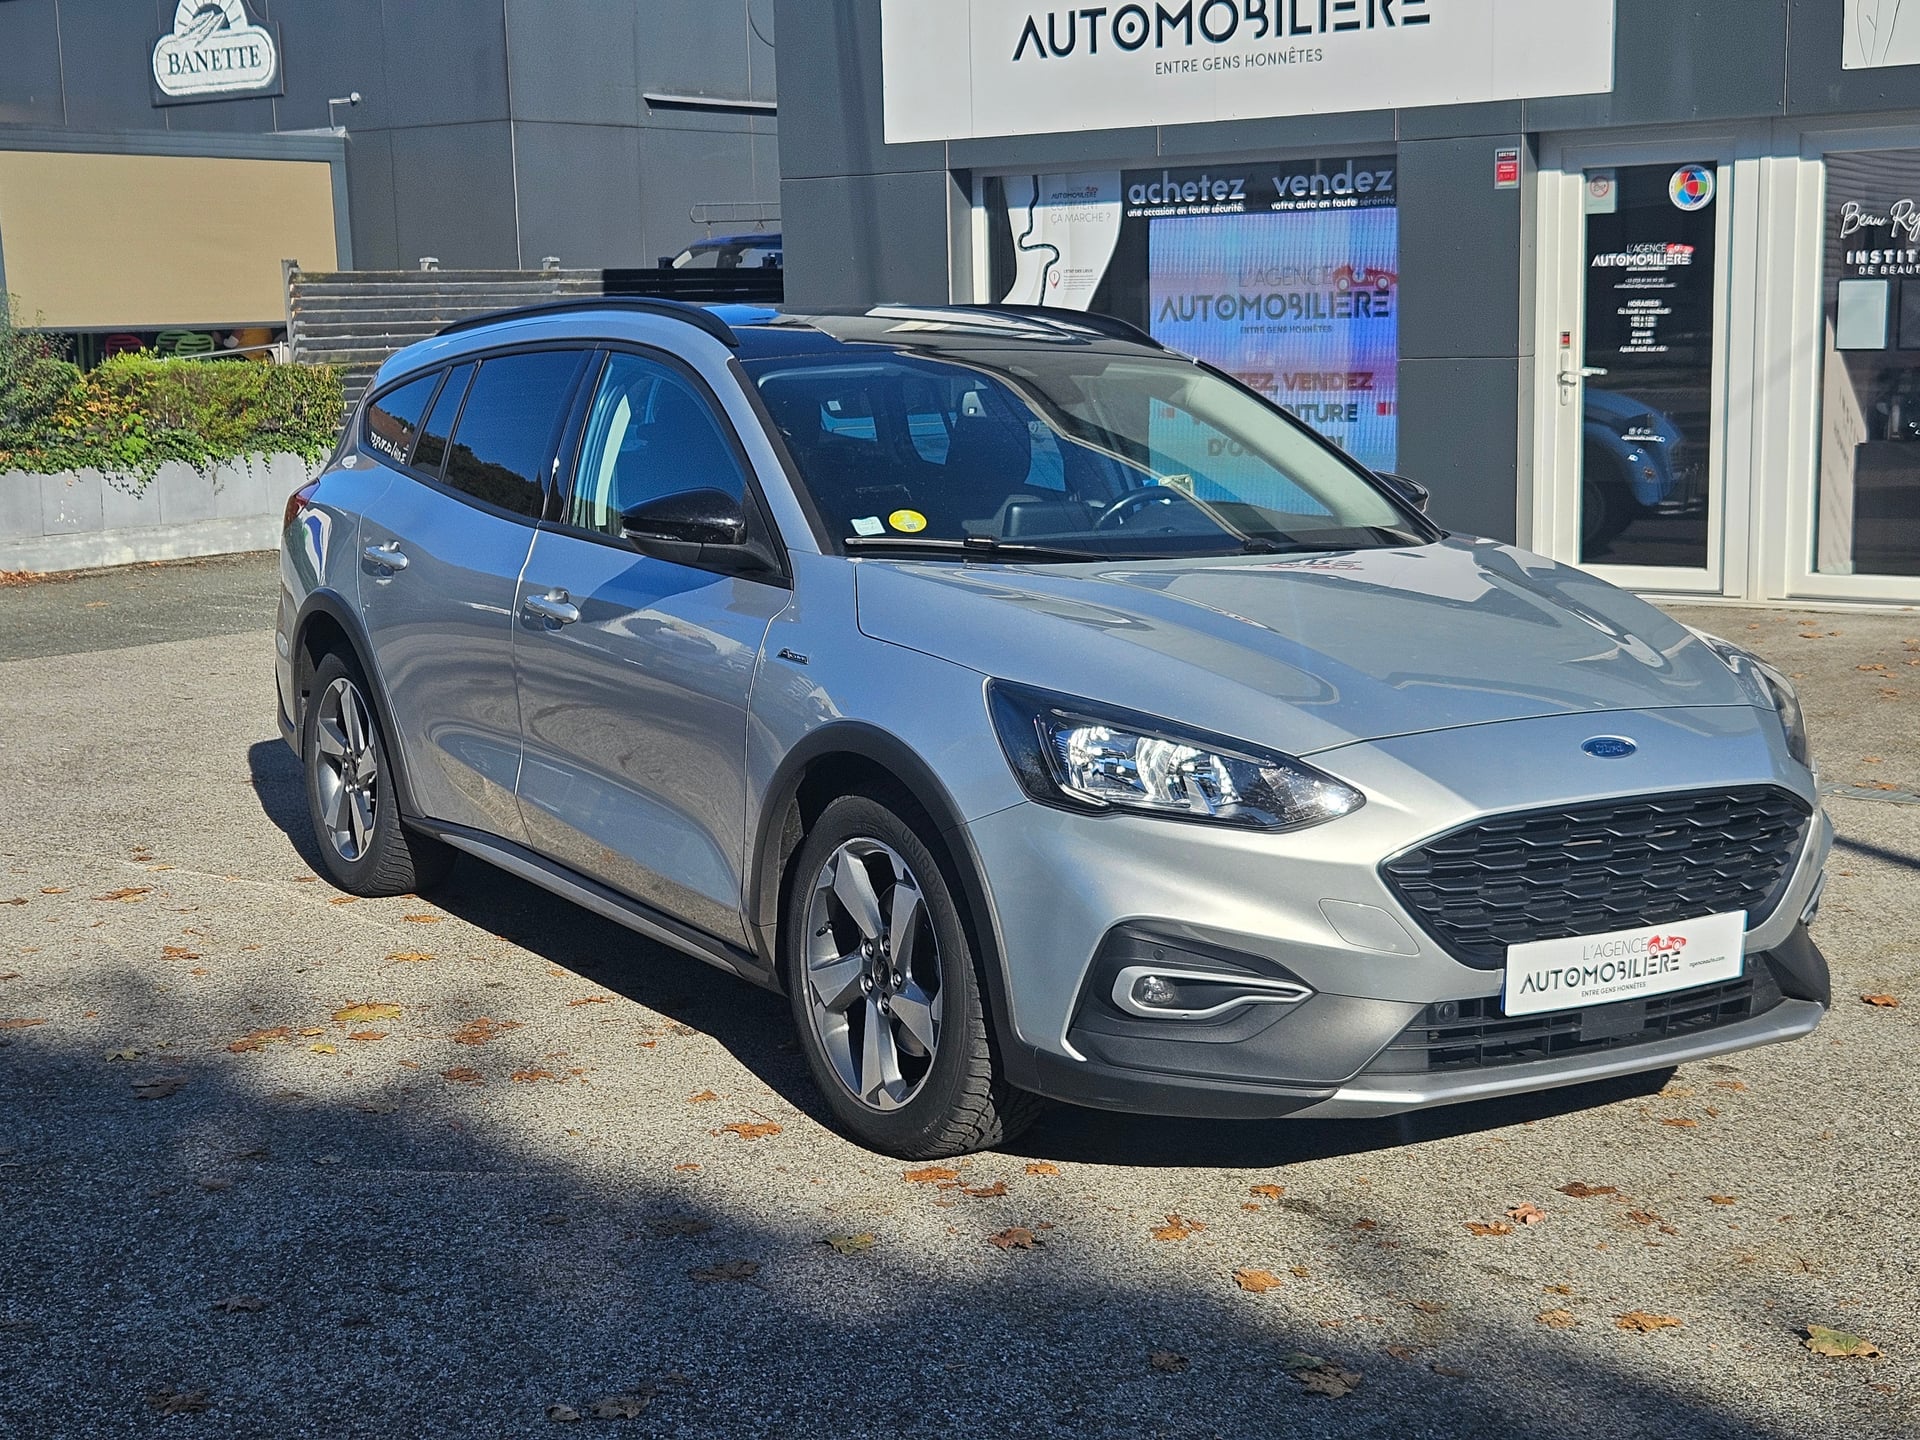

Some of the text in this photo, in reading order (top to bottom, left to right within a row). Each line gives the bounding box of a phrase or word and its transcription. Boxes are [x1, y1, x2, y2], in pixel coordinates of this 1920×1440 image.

[167, 45, 262, 76] BANETTE
[1155, 47, 1323, 75] ENTRE GENS HONNÊTES
[1128, 170, 1246, 204] achetez
[1271, 160, 1393, 197] vendez
[1127, 209, 1142, 217] une
[1143, 206, 1175, 216] occasion
[1177, 206, 1187, 214] en
[1188, 203, 1209, 214] toute
[1271, 200, 1294, 210] votre
[1296, 199, 1317, 209] auto
[1318, 200, 1330, 208] en
[1332, 198, 1358, 207] toute
[1065, 212, 1104, 223] MARCHE
[1840, 201, 1887, 239] Beau
[1626, 243, 1667, 253] L'AGENCE
[1238, 264, 1334, 288] L'AGENCE
[1858, 265, 1876, 275] DE
[1266, 325, 1287, 334] GENS
[1282, 371, 1374, 392] VENDEZ
[1583, 937, 1648, 961] L'AGENCE
[1581, 988, 1600, 998] ENTRE
[1600, 985, 1617, 995] GENS
